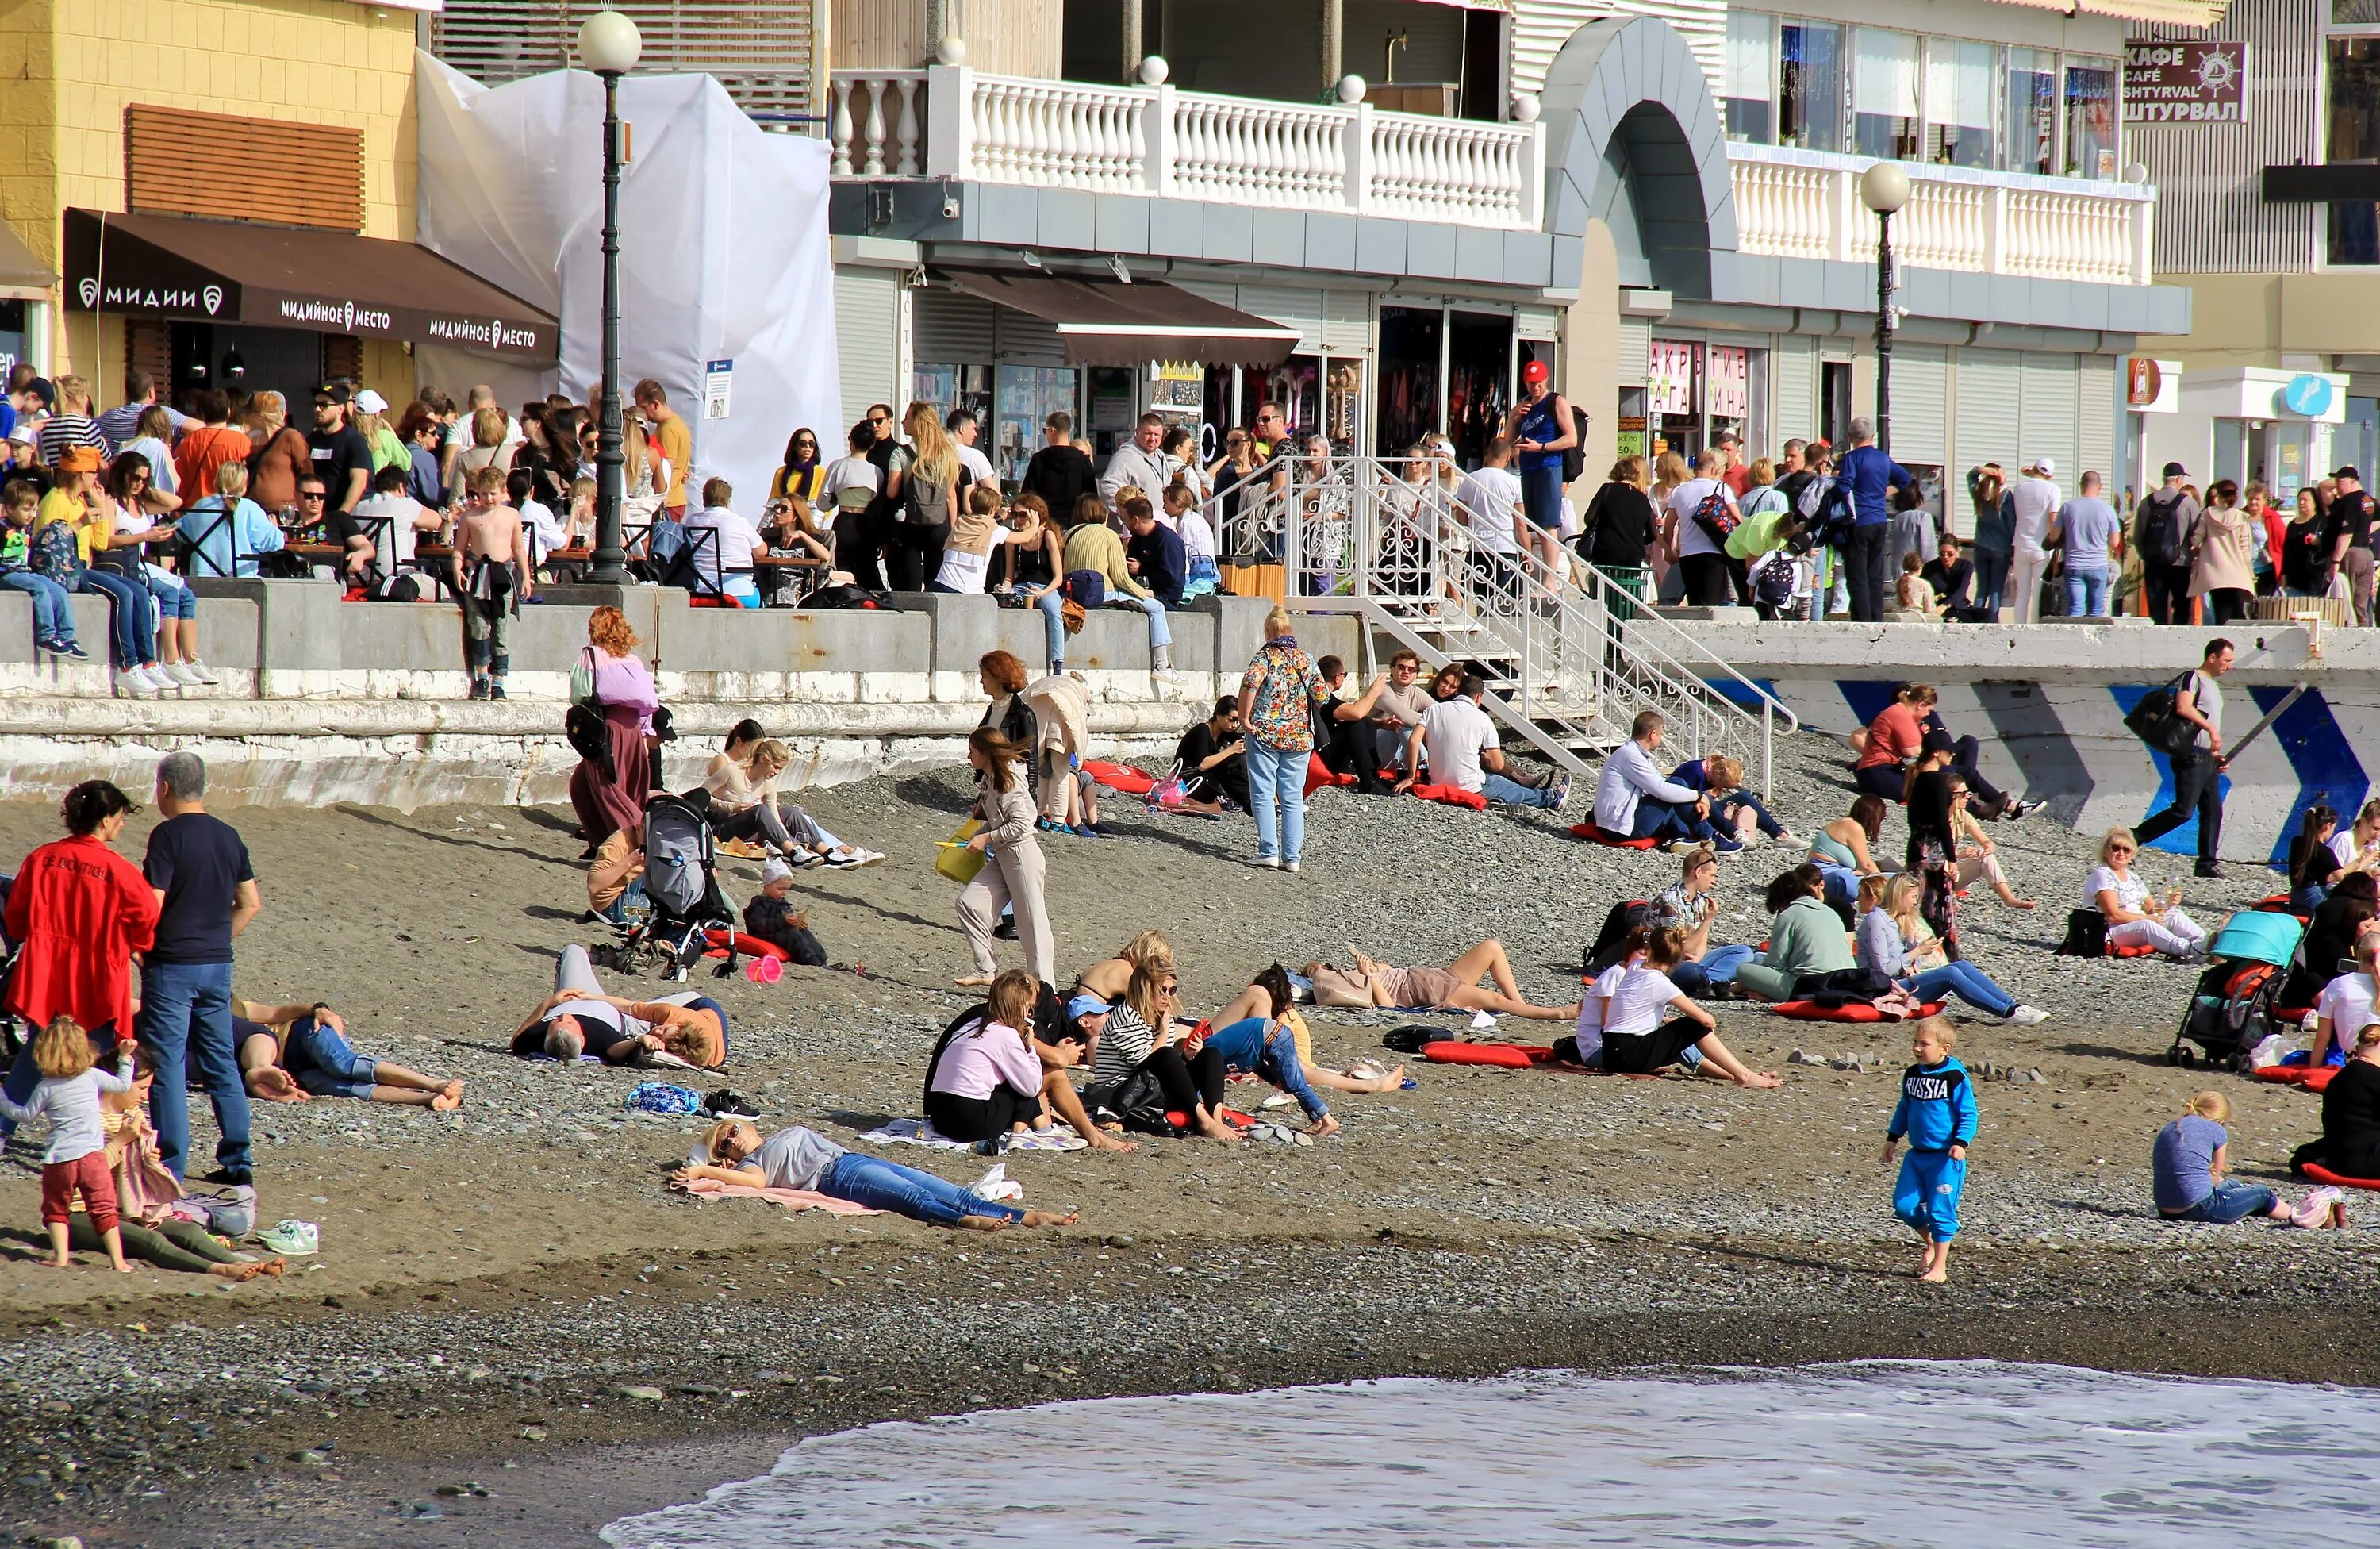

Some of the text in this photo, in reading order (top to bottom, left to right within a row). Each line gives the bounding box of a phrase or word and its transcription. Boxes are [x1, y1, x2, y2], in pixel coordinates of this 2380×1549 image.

[2125, 48, 2184, 66] КАФЕ
[2124, 68, 2161, 82] CAFÉ
[2123, 86, 2199, 98] SHTYRVAL
[2123, 102, 2238, 121] ШТУРВАЛ
[106, 286, 195, 307] МИДИИ
[281, 300, 390, 329] МИДИЙНОЕ МЕСТО
[429, 319, 536, 348] МИДИЙНОЕ МЕСТО
[1905, 1077, 1948, 1100] RUSSIA
